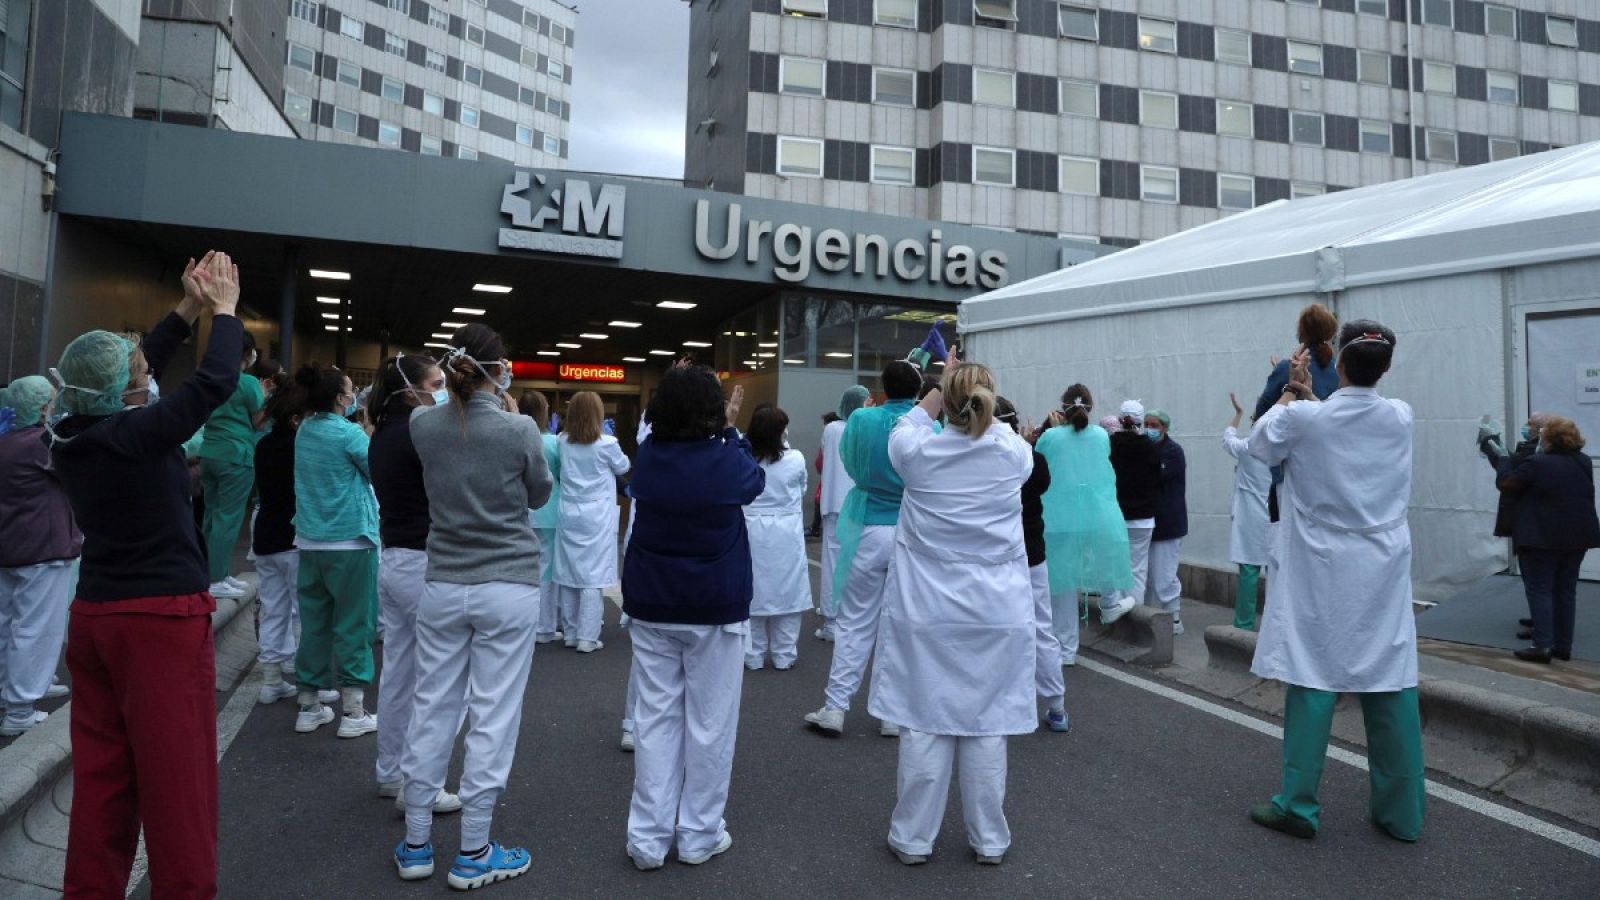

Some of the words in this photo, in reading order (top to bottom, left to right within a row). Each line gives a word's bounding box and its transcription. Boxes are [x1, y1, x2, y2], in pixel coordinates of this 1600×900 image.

[562, 178, 626, 237] M
[694, 198, 1010, 290] Urgencias
[560, 364, 625, 380] Urgencias
